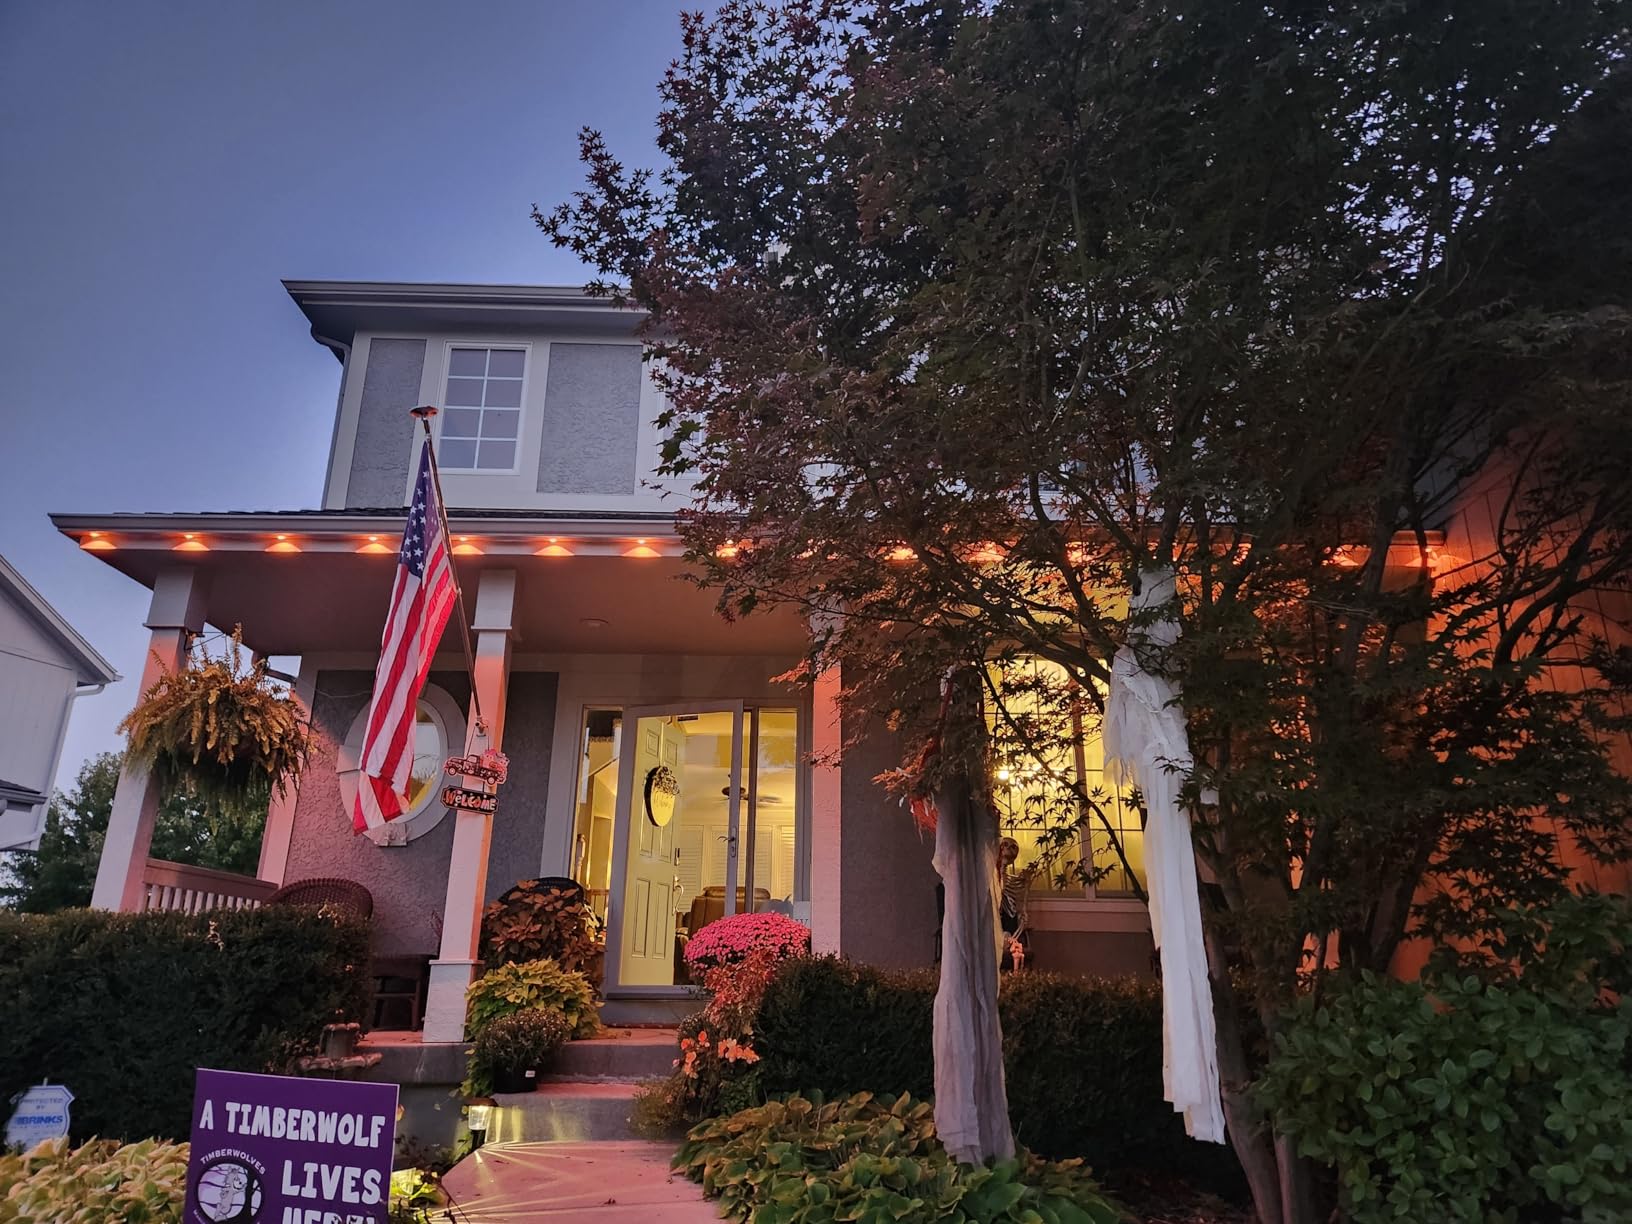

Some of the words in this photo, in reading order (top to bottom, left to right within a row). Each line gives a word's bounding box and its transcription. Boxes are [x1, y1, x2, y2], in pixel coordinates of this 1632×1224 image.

[199, 1099, 214, 1130] A
[225, 1101, 386, 1148] TIMBERWOLF
[200, 1148, 266, 1175] TIMBERWOLVES
[281, 1160, 382, 1205] LIVES
